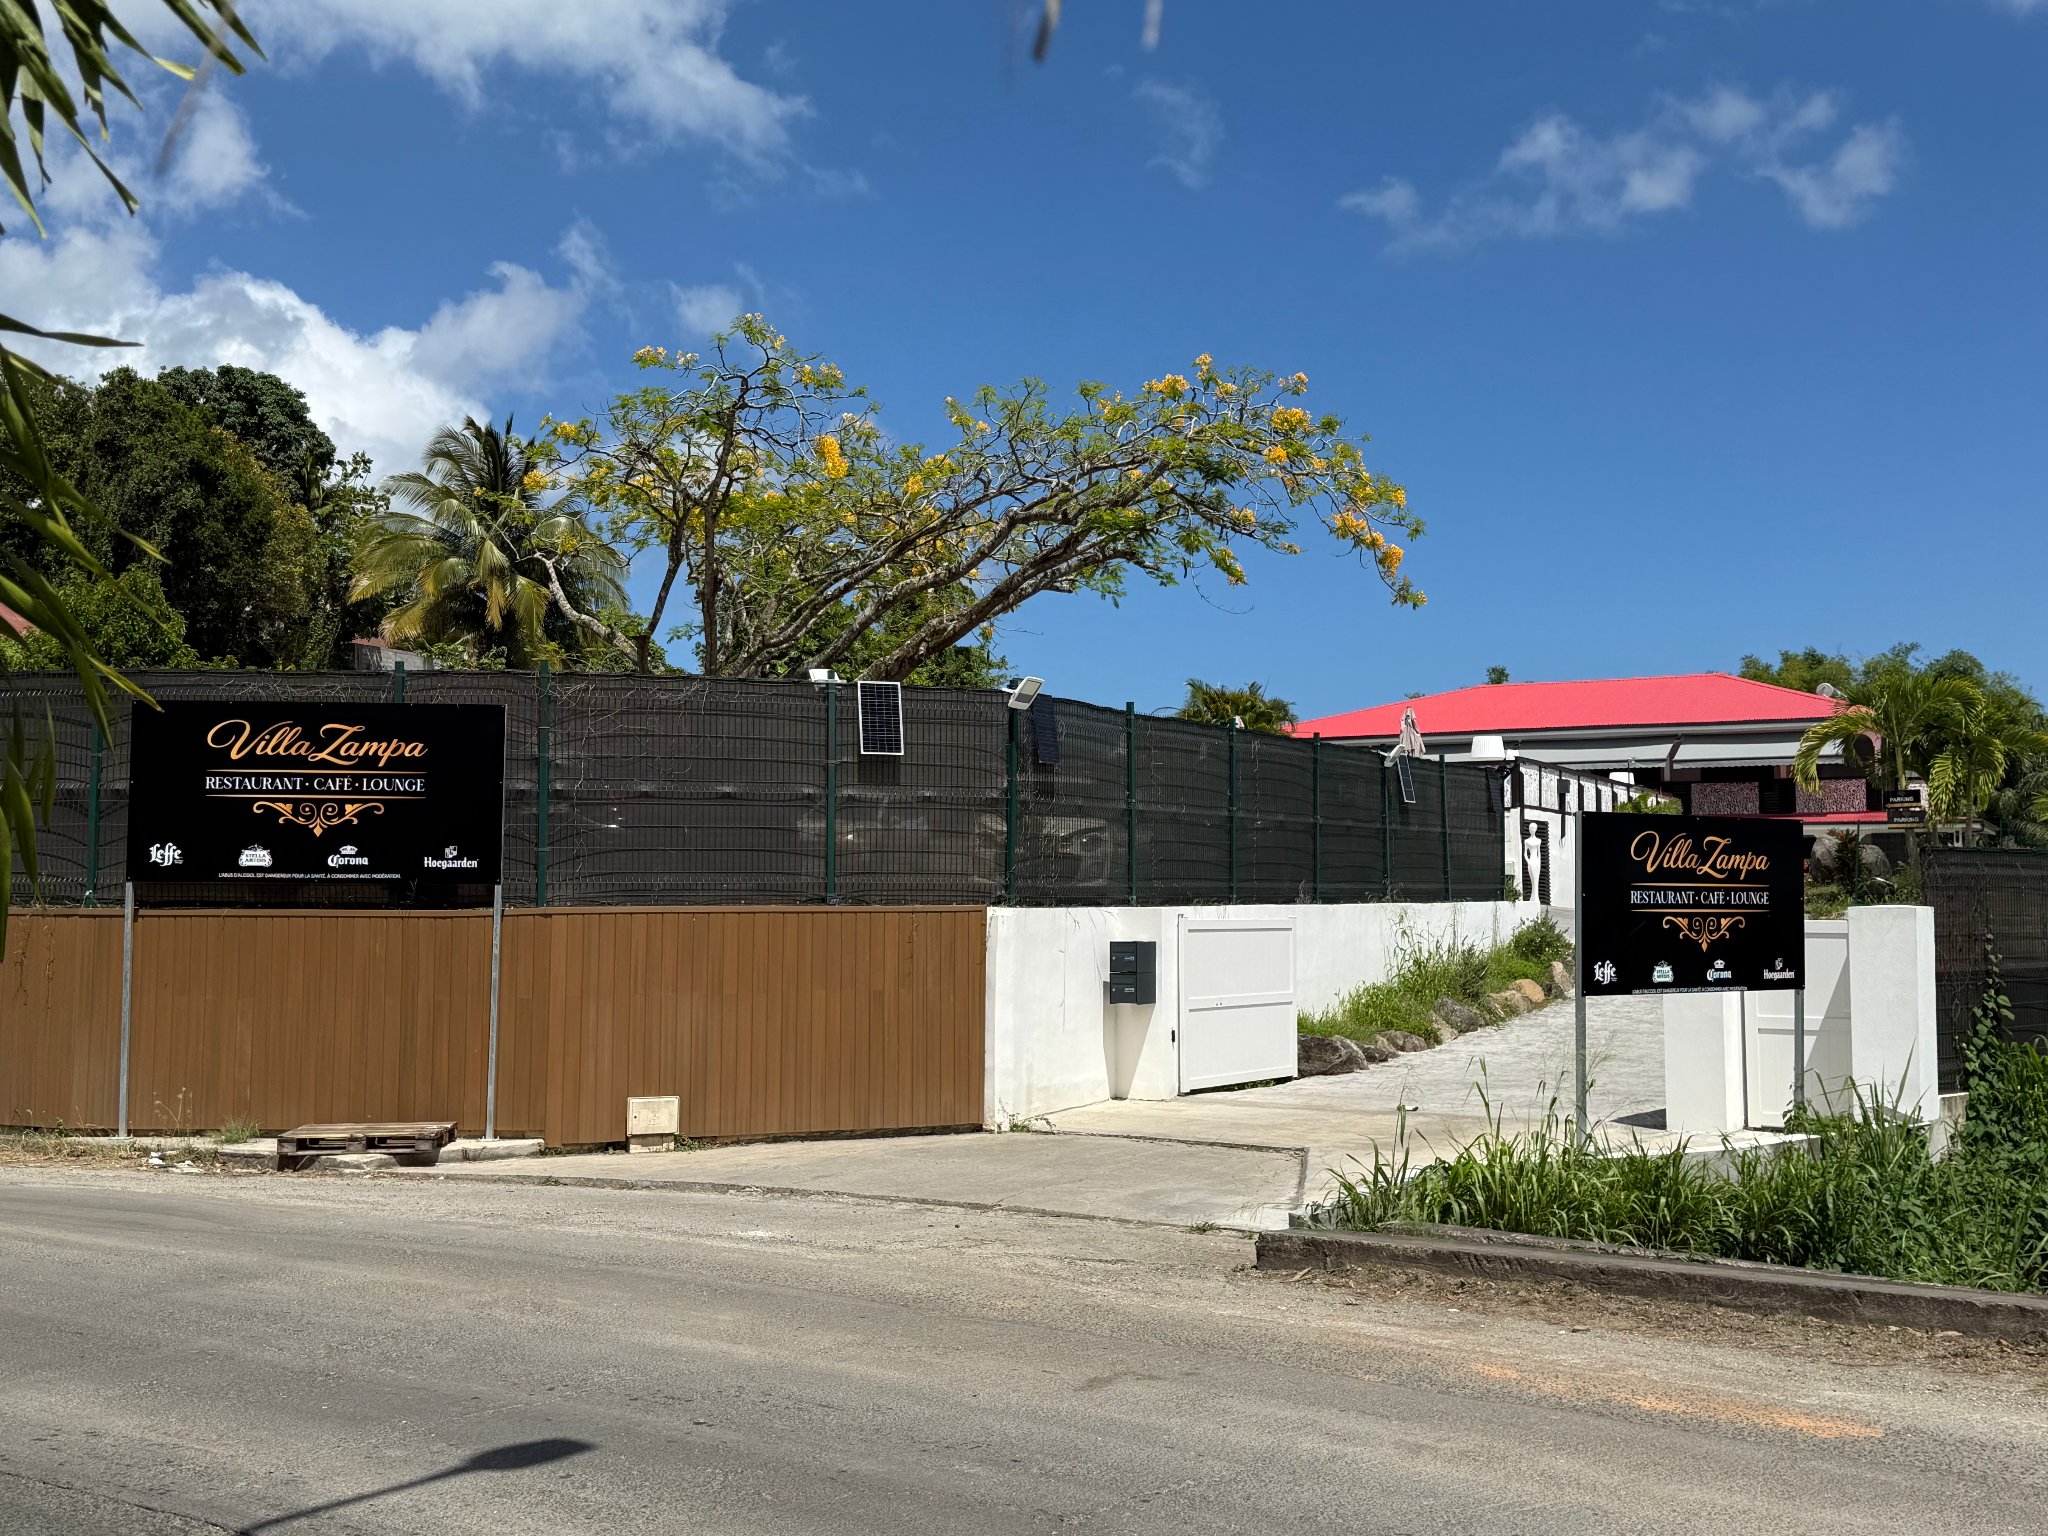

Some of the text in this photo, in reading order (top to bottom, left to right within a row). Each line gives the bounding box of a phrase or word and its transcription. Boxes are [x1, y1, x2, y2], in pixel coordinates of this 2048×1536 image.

[206, 719, 428, 767] Villa Zampa
[205, 776, 425, 792] RESTAURANT CAFÉ LOUNGE
[149, 842, 182, 867] Leffe
[327, 854, 369, 868] Corona
[1630, 830, 1770, 880] Villa Zampa
[423, 856, 478, 870] Hoegaarden
[1630, 889, 1770, 905] RESTAURANT CAFÉ LOUNGE
[1593, 960, 1617, 985] Leffe
[1707, 968, 1732, 980] Corona
[1763, 968, 1795, 980] Hoegaarden
